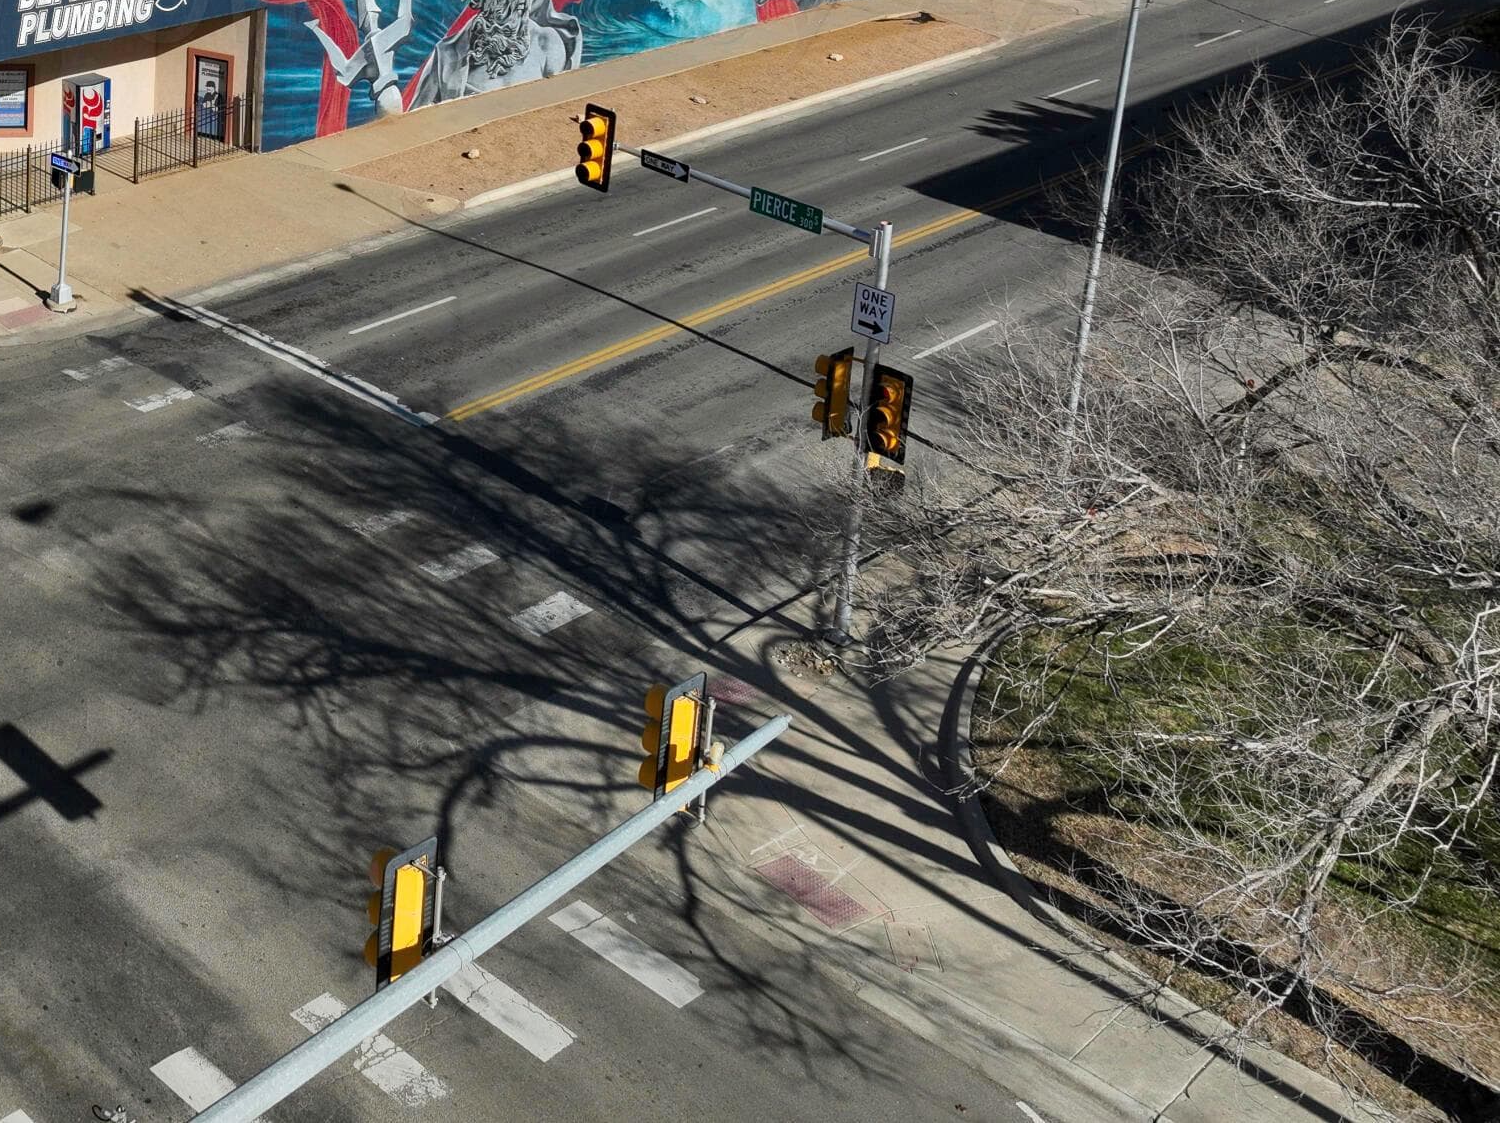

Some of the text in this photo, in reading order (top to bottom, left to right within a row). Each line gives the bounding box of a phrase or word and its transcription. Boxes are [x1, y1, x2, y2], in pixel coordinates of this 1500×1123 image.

[82, 88, 104, 130] RC
[644, 154, 675, 174] ONE WAY
[753, 191, 815, 222] PIERCE ST
[799, 217, 813, 230] 300
[862, 289, 889, 308] ONE
[860, 301, 887, 320] WAY
